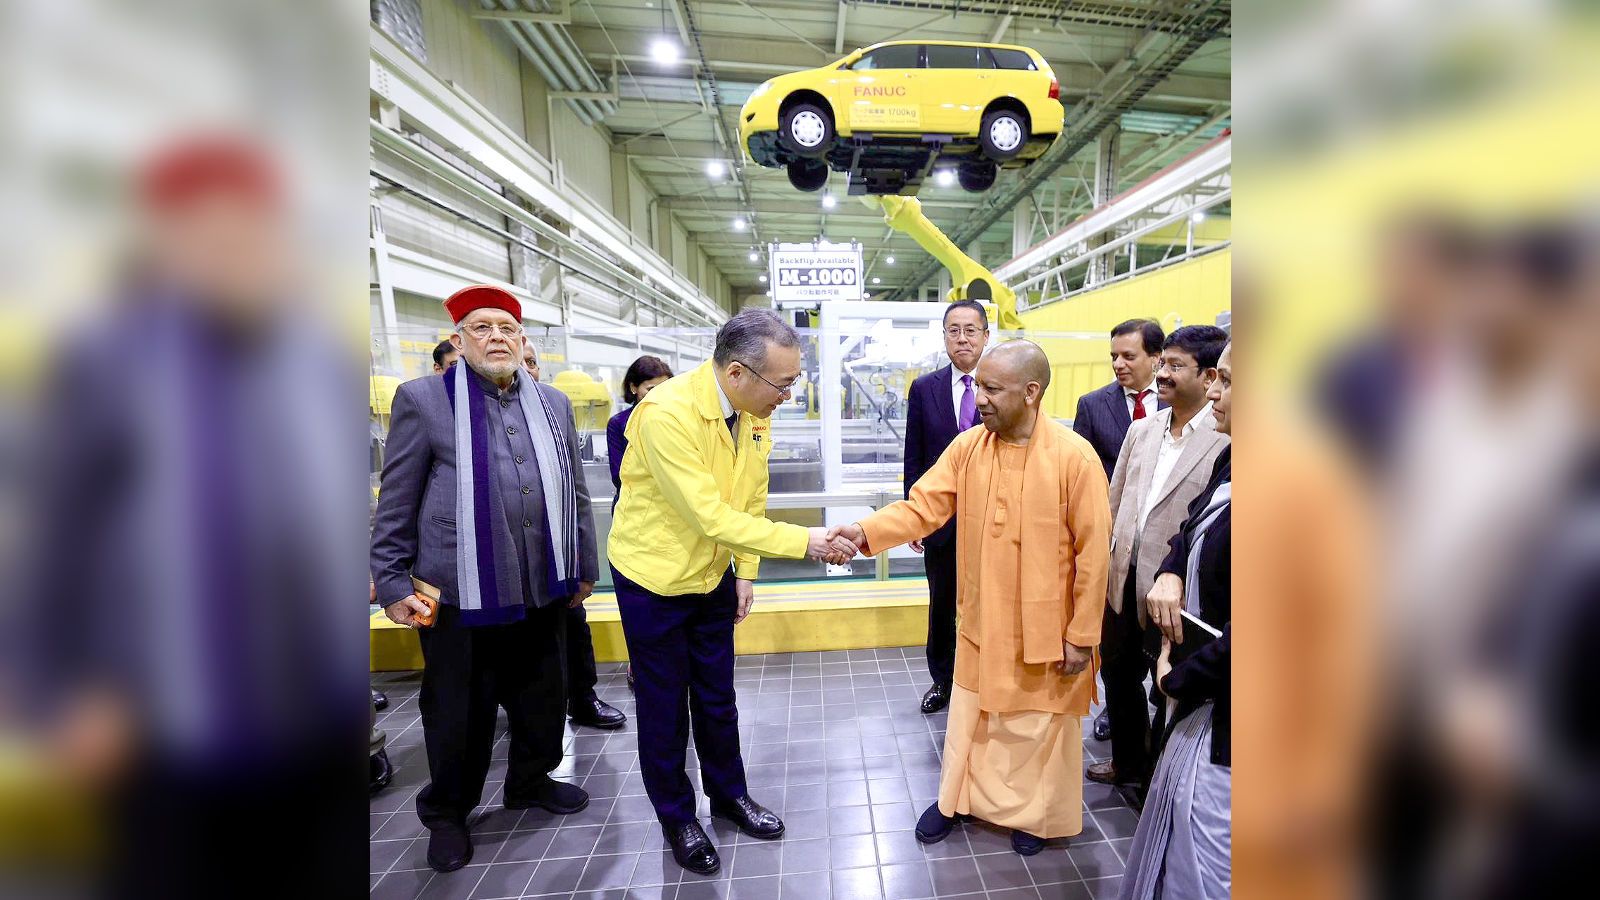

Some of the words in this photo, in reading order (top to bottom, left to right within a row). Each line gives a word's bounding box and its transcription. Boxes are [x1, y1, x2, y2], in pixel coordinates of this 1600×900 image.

[854, 86, 906, 97] FANUC
[888, 108, 916, 118] 1700kg
[780, 257, 815, 266] Backflip
[817, 257, 855, 265] Available
[780, 268, 856, 286] M-1000
